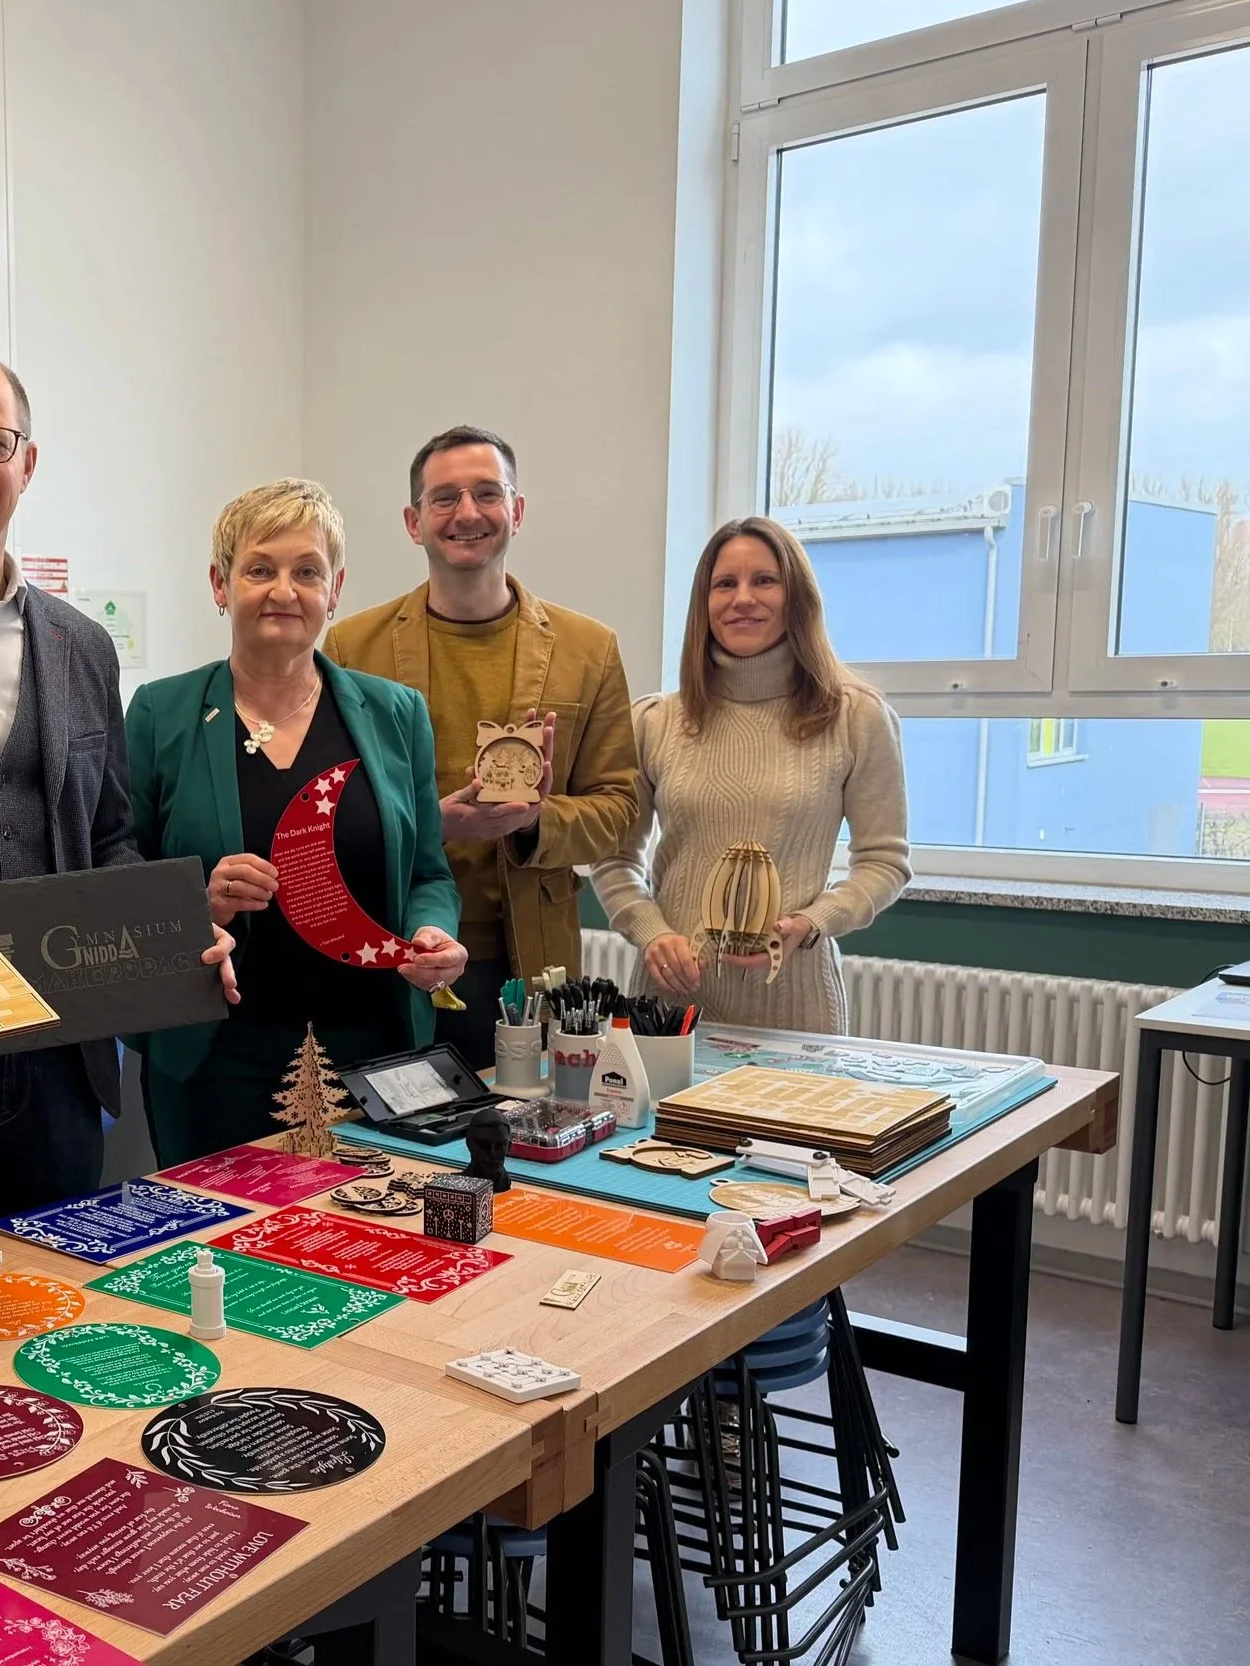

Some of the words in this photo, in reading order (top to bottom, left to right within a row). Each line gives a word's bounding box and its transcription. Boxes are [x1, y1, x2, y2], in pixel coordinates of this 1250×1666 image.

[276, 831, 289, 840] The
[290, 827, 307, 837] Dark
[307, 821, 331, 833] Knight
[40, 920, 183, 970] GYMNASIUM
[84, 925, 139, 966] NIDDA
[310, 1451, 353, 1473] Lifestyles
[241, 1531, 272, 1553] LOVE
[196, 1552, 250, 1590] WITHOUT
[162, 1587, 201, 1609] FEAR
